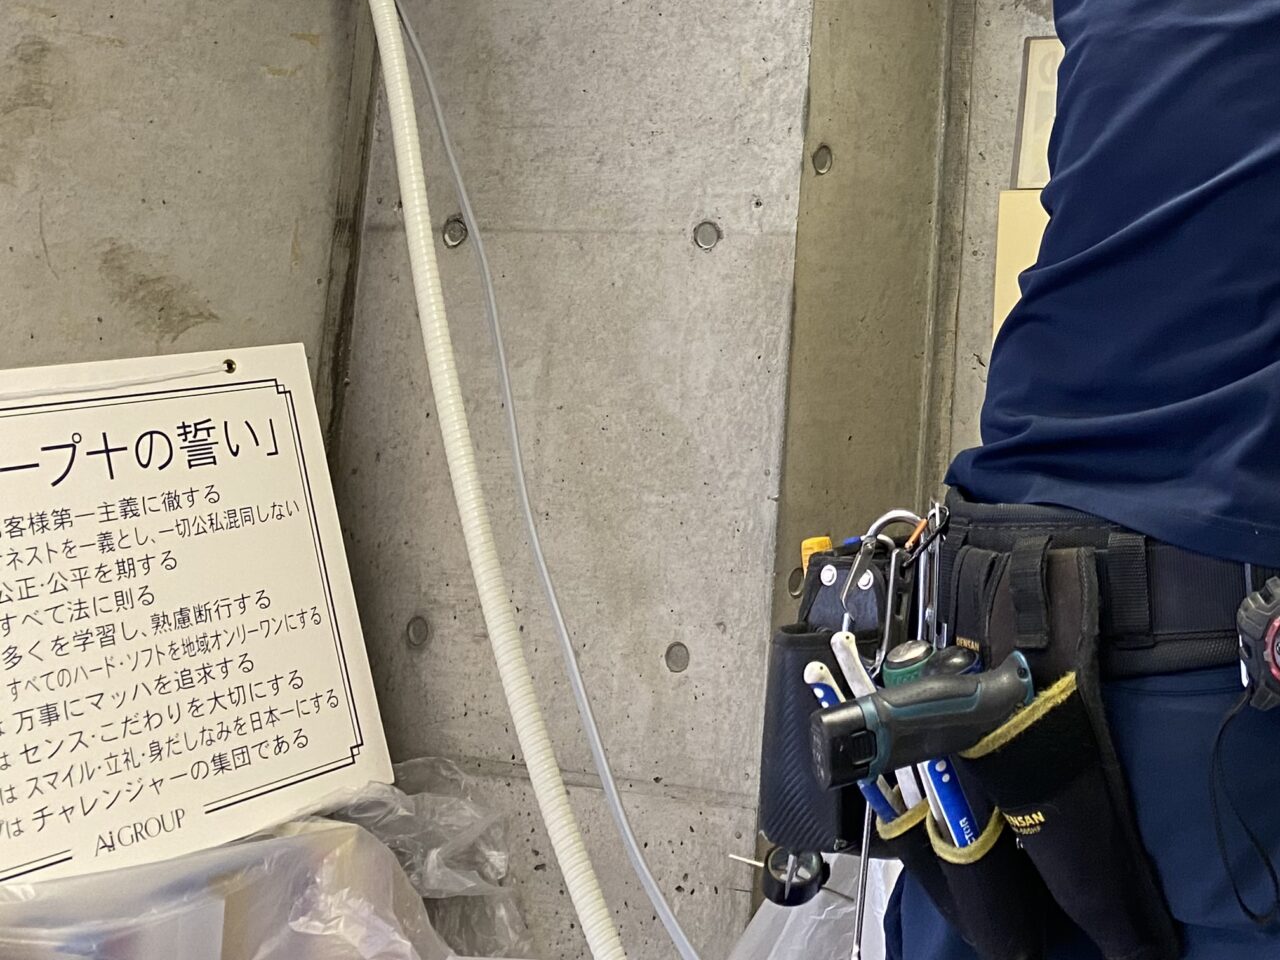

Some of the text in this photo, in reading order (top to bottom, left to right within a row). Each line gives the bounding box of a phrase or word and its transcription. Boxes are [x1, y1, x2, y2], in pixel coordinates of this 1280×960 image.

[0, 484, 221, 541] 客様第一主義に徹する
[0, 500, 300, 572] ネストを一義とし、一切公私混同しない
[0, 585, 156, 638] すべて法に則る
